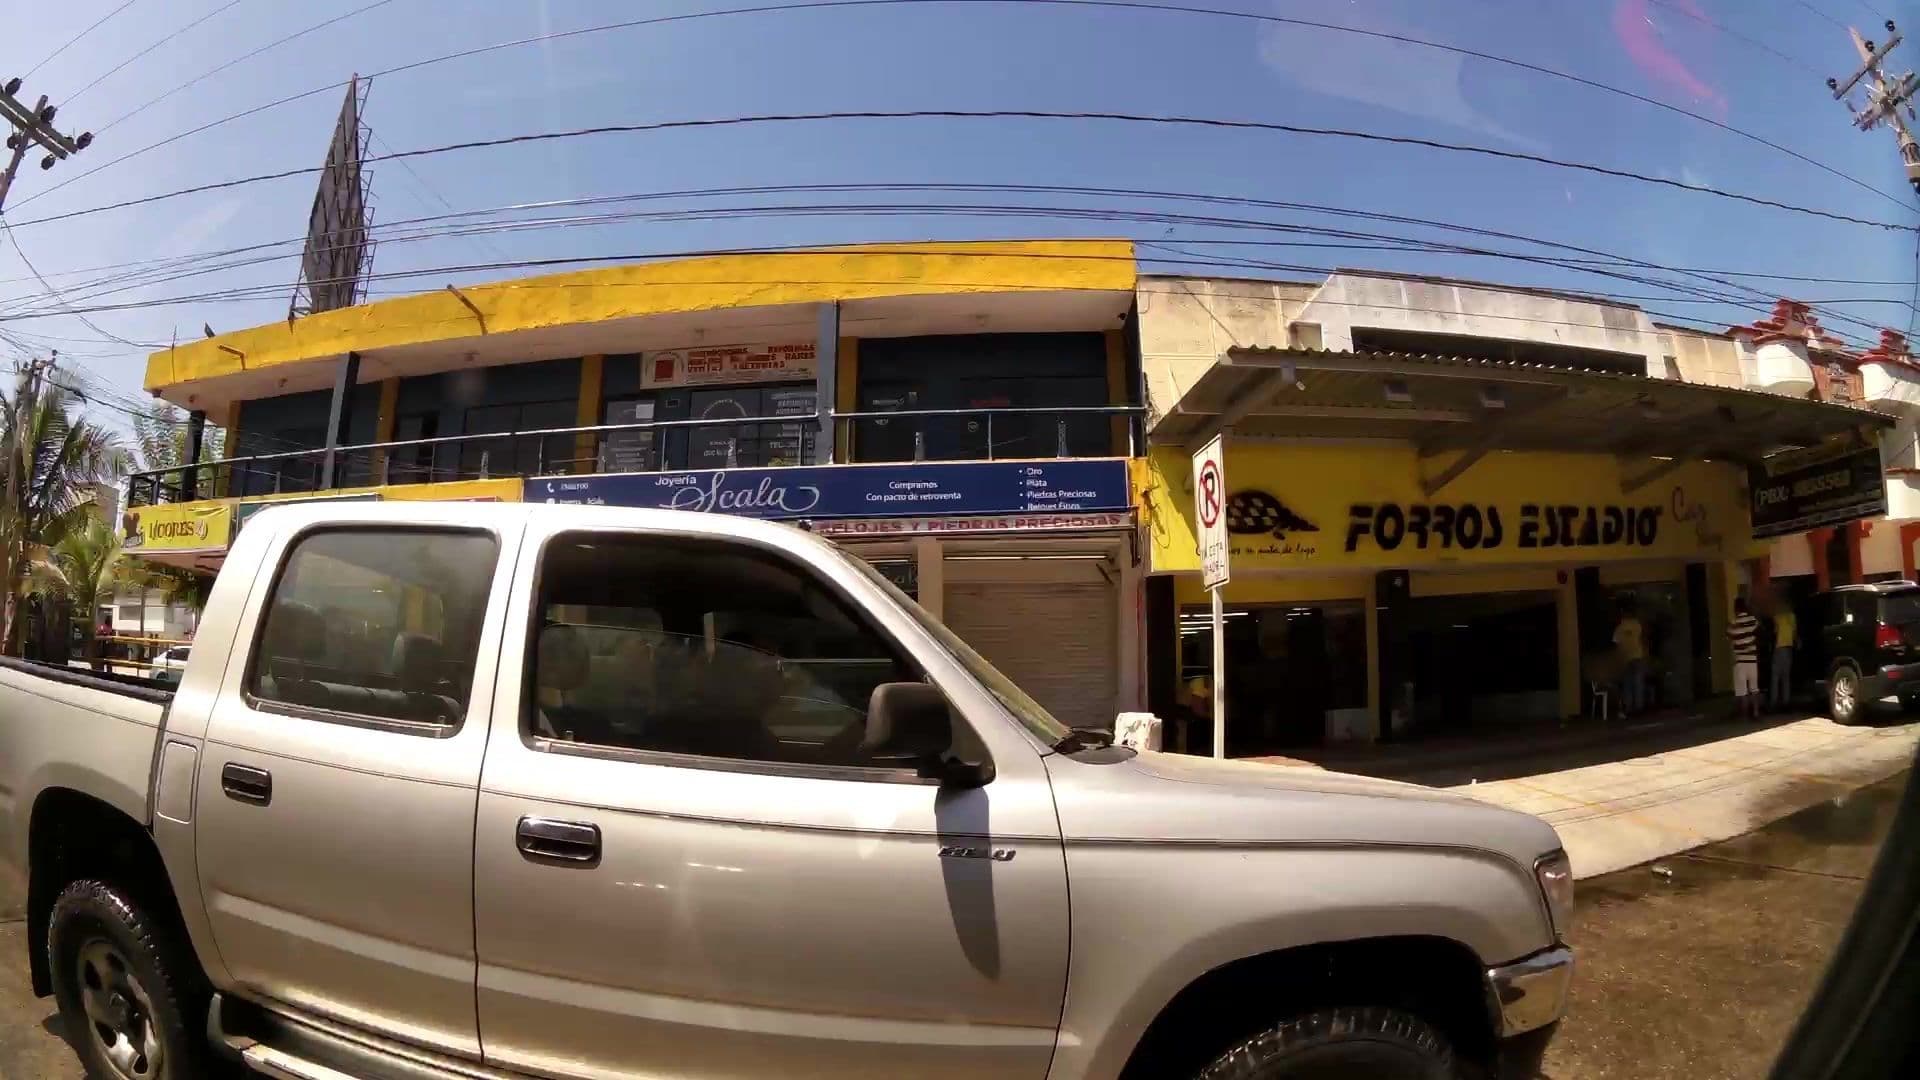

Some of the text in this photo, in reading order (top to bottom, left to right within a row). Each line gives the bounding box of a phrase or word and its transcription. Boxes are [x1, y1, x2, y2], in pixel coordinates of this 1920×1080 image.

[1026, 467, 1043, 475] Oro
[655, 475, 697, 488] Joyería
[888, 481, 939, 490] Compramos
[1026, 479, 1048, 487] Plata
[659, 472, 820, 513] Scala
[865, 492, 961, 502] Con pacto de retroventa
[1027, 489, 1097, 499] Piedras Preciosas
[927, 519, 1008, 531] PIEDRAS
[1014, 514, 1120, 528] PRECIOSAS
[1345, 503, 1503, 552] FORROS
[1518, 505, 1664, 548] ESTADIO
